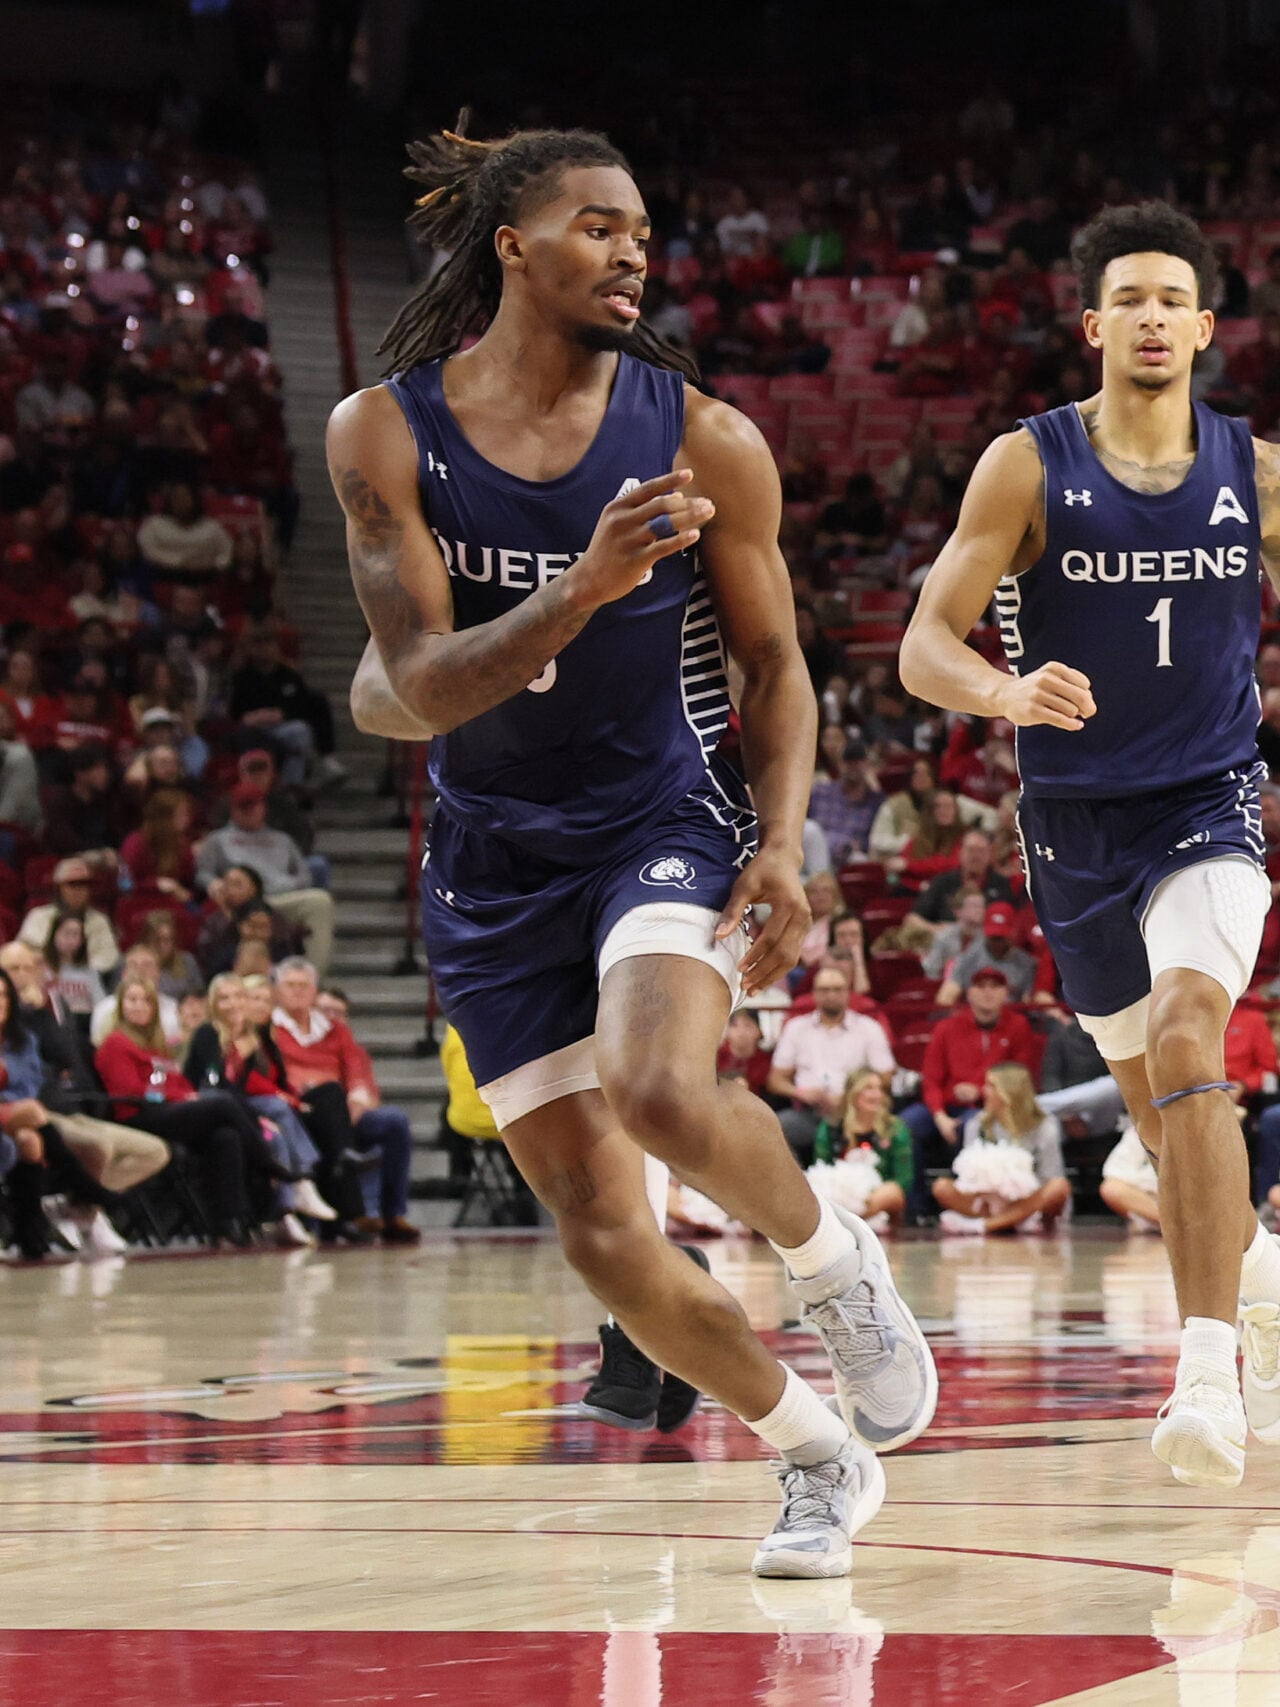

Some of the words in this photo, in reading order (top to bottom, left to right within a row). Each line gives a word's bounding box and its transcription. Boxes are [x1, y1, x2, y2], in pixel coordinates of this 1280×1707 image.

[431, 528, 653, 590] UEE
[1061, 545, 1249, 583] QUEENS
[1145, 598, 1173, 667] 1
